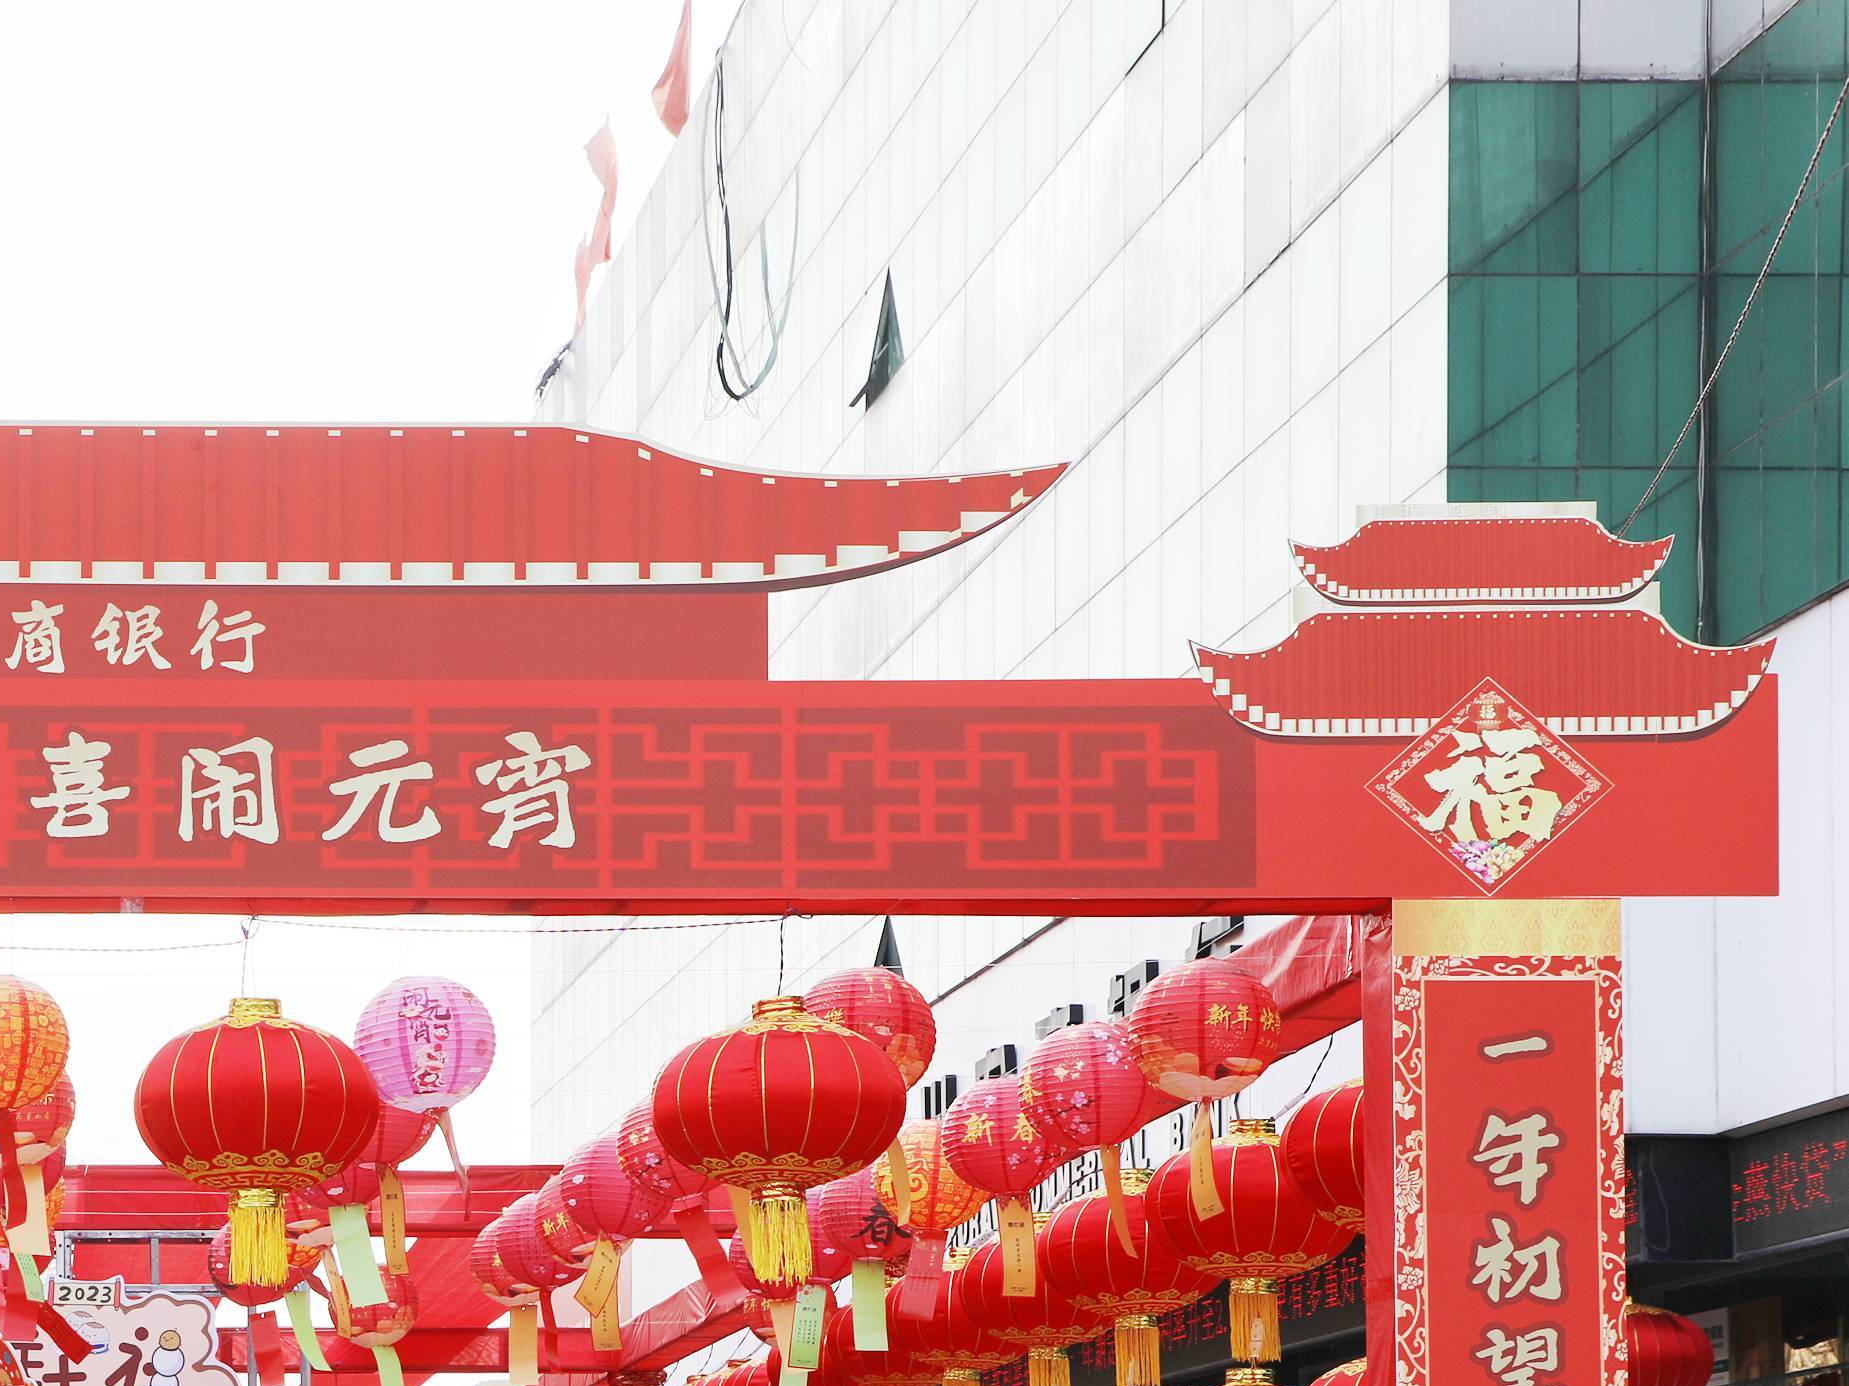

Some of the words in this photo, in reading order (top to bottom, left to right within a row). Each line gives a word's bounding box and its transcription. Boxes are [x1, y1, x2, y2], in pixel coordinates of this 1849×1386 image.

[31, 731, 592, 850] 喜闹元宵
[1417, 727, 1563, 842] 福
[960, 1111, 1045, 1147] 新春
[58, 1285, 112, 1303] 2023
